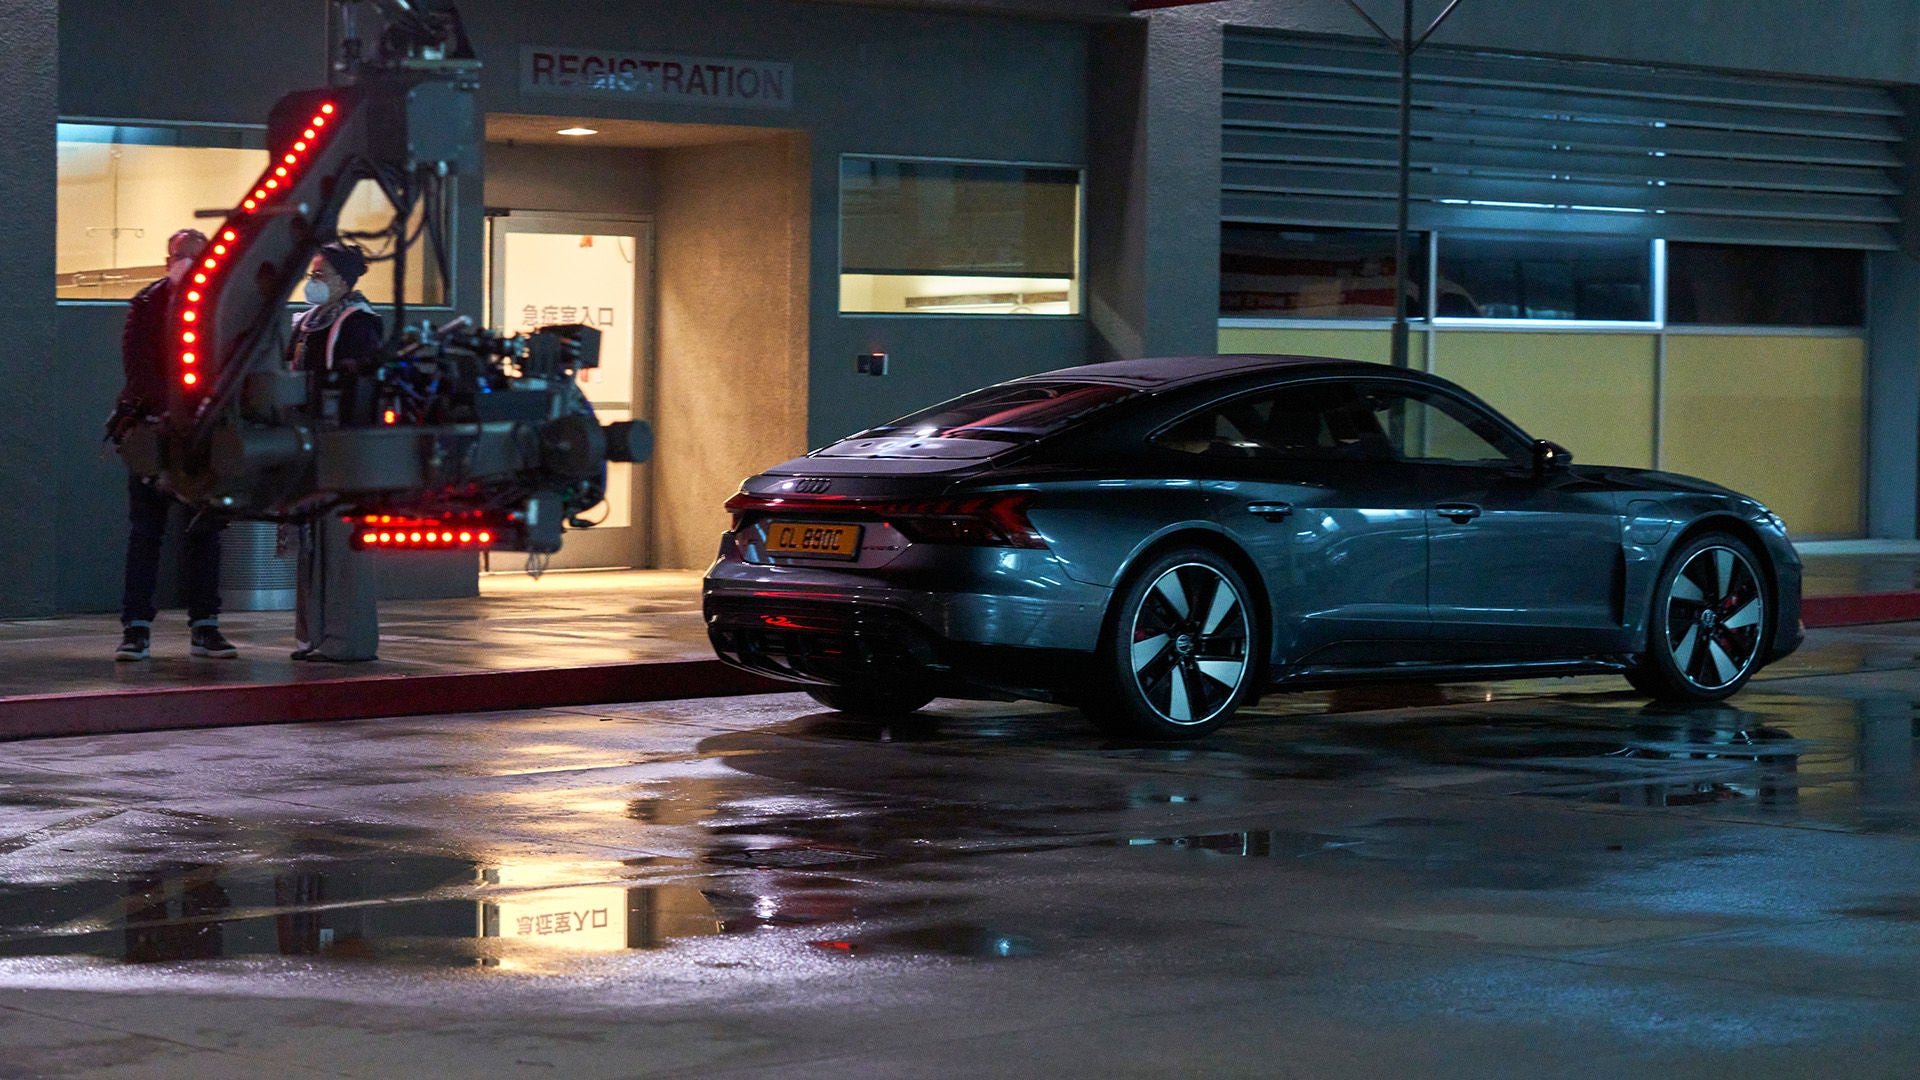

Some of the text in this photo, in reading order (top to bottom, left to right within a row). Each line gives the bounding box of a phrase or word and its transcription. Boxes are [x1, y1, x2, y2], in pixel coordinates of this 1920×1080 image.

[532, 52, 784, 100] REGISTRATION
[522, 304, 614, 326] 急症室入口
